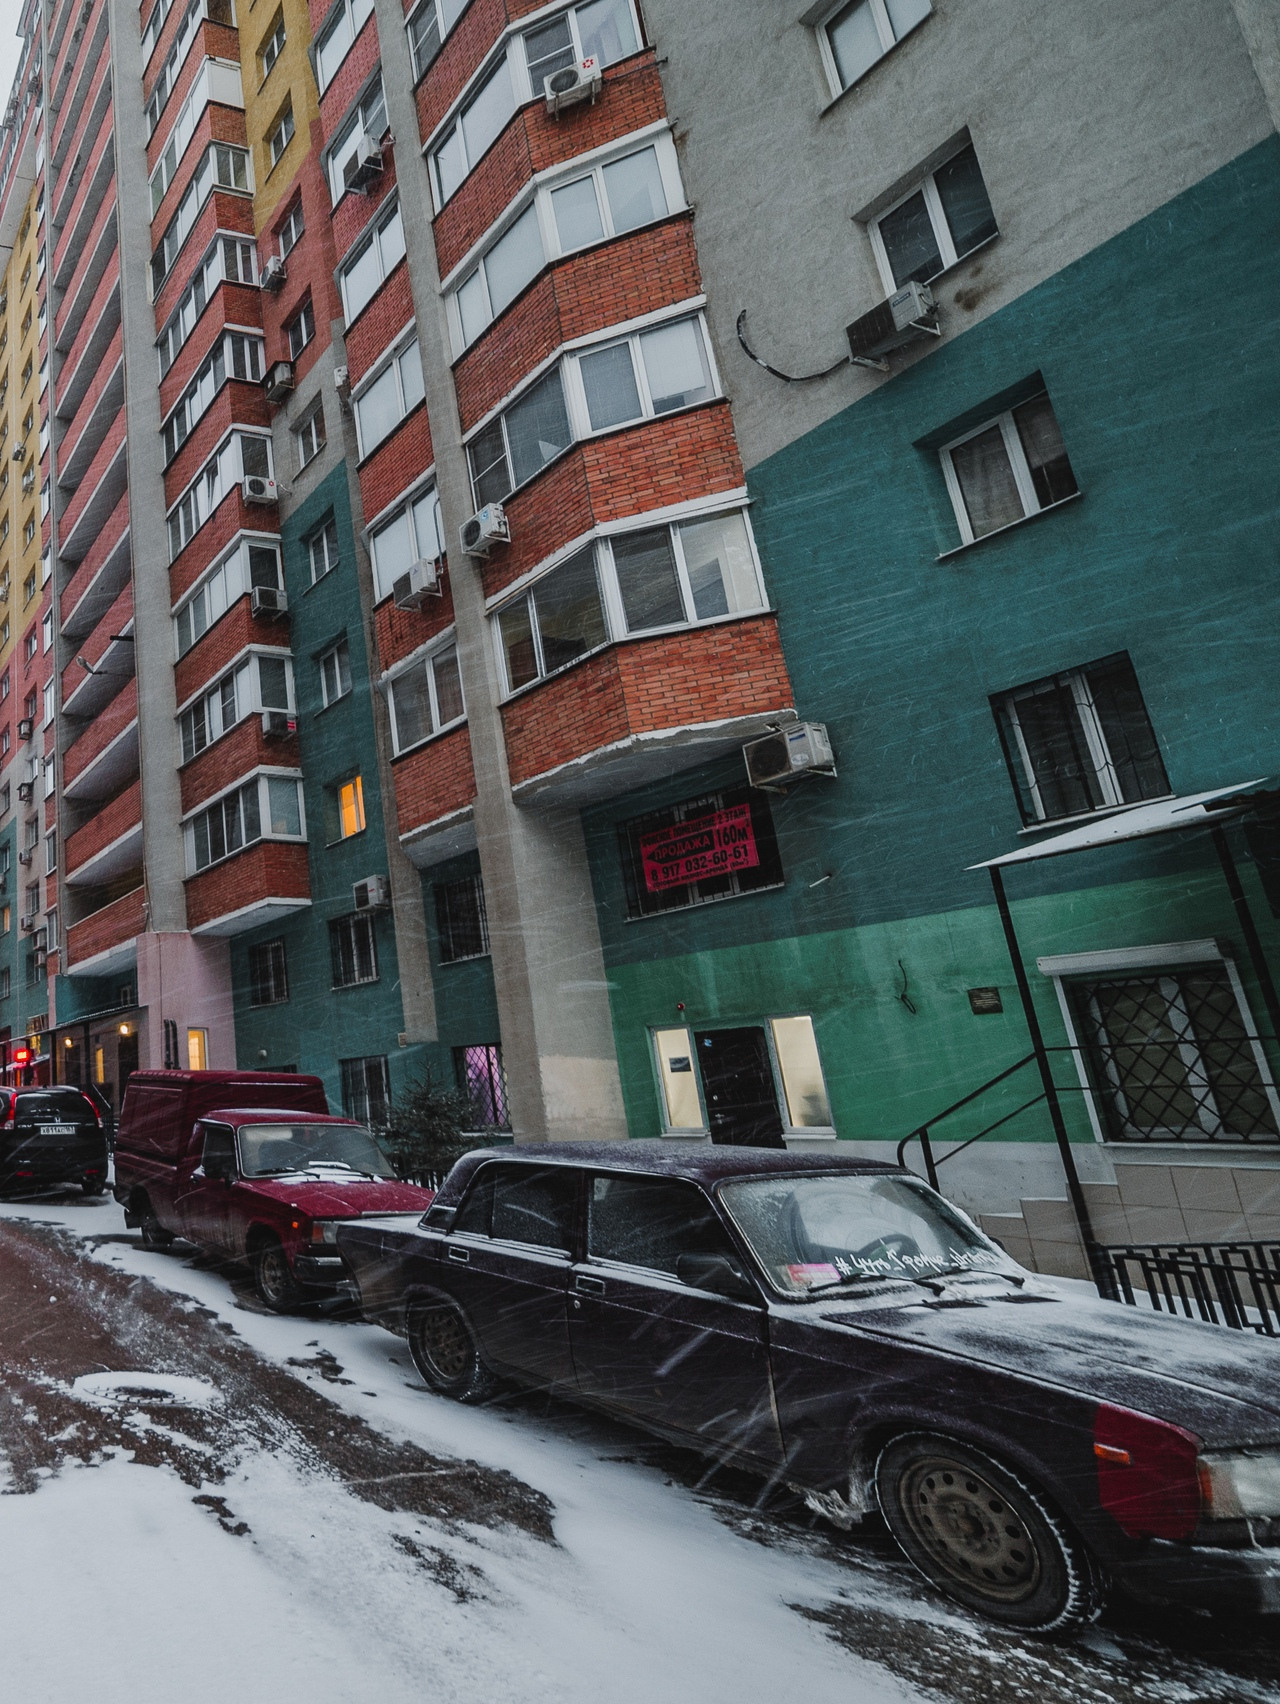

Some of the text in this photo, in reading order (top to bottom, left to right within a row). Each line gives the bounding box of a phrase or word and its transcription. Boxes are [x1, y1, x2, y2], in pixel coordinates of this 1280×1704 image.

[673, 818, 715, 837] ПОМЕЩЕНИЕ
[718, 813, 724, 824] 2
[725, 808, 747, 822] ЭТАЖ
[651, 844, 748, 881] 8 917 032-60-61
[655, 836, 709, 860] ПРОДАЖА
